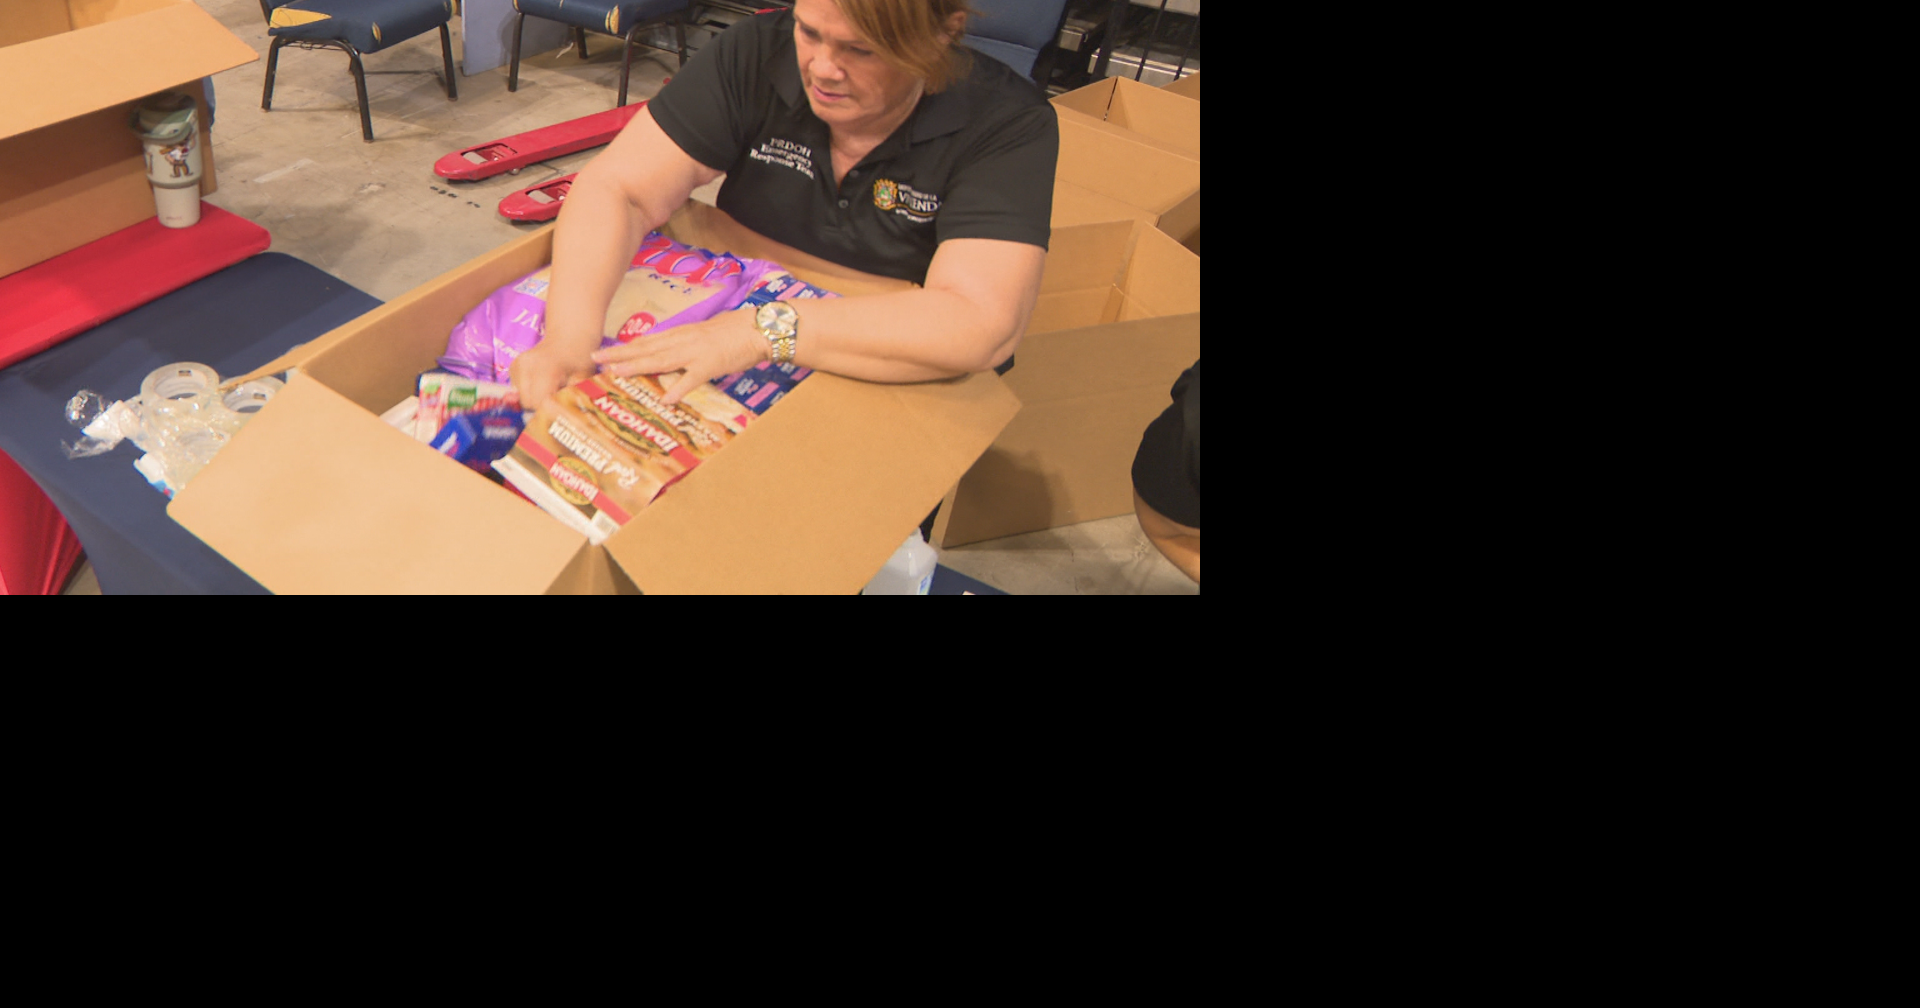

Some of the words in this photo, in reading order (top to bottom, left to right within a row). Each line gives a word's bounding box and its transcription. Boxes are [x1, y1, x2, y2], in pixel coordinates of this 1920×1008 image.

[750, 148, 795, 169] Response
[761, 143, 812, 168] Emergency
[770, 137, 812, 158] PRDOH
[612, 376, 684, 427] PREMIUM
[592, 397, 679, 452] IDAHOAN
[546, 420, 608, 472] PREMIUM
[548, 461, 599, 502] IDAHOAN
